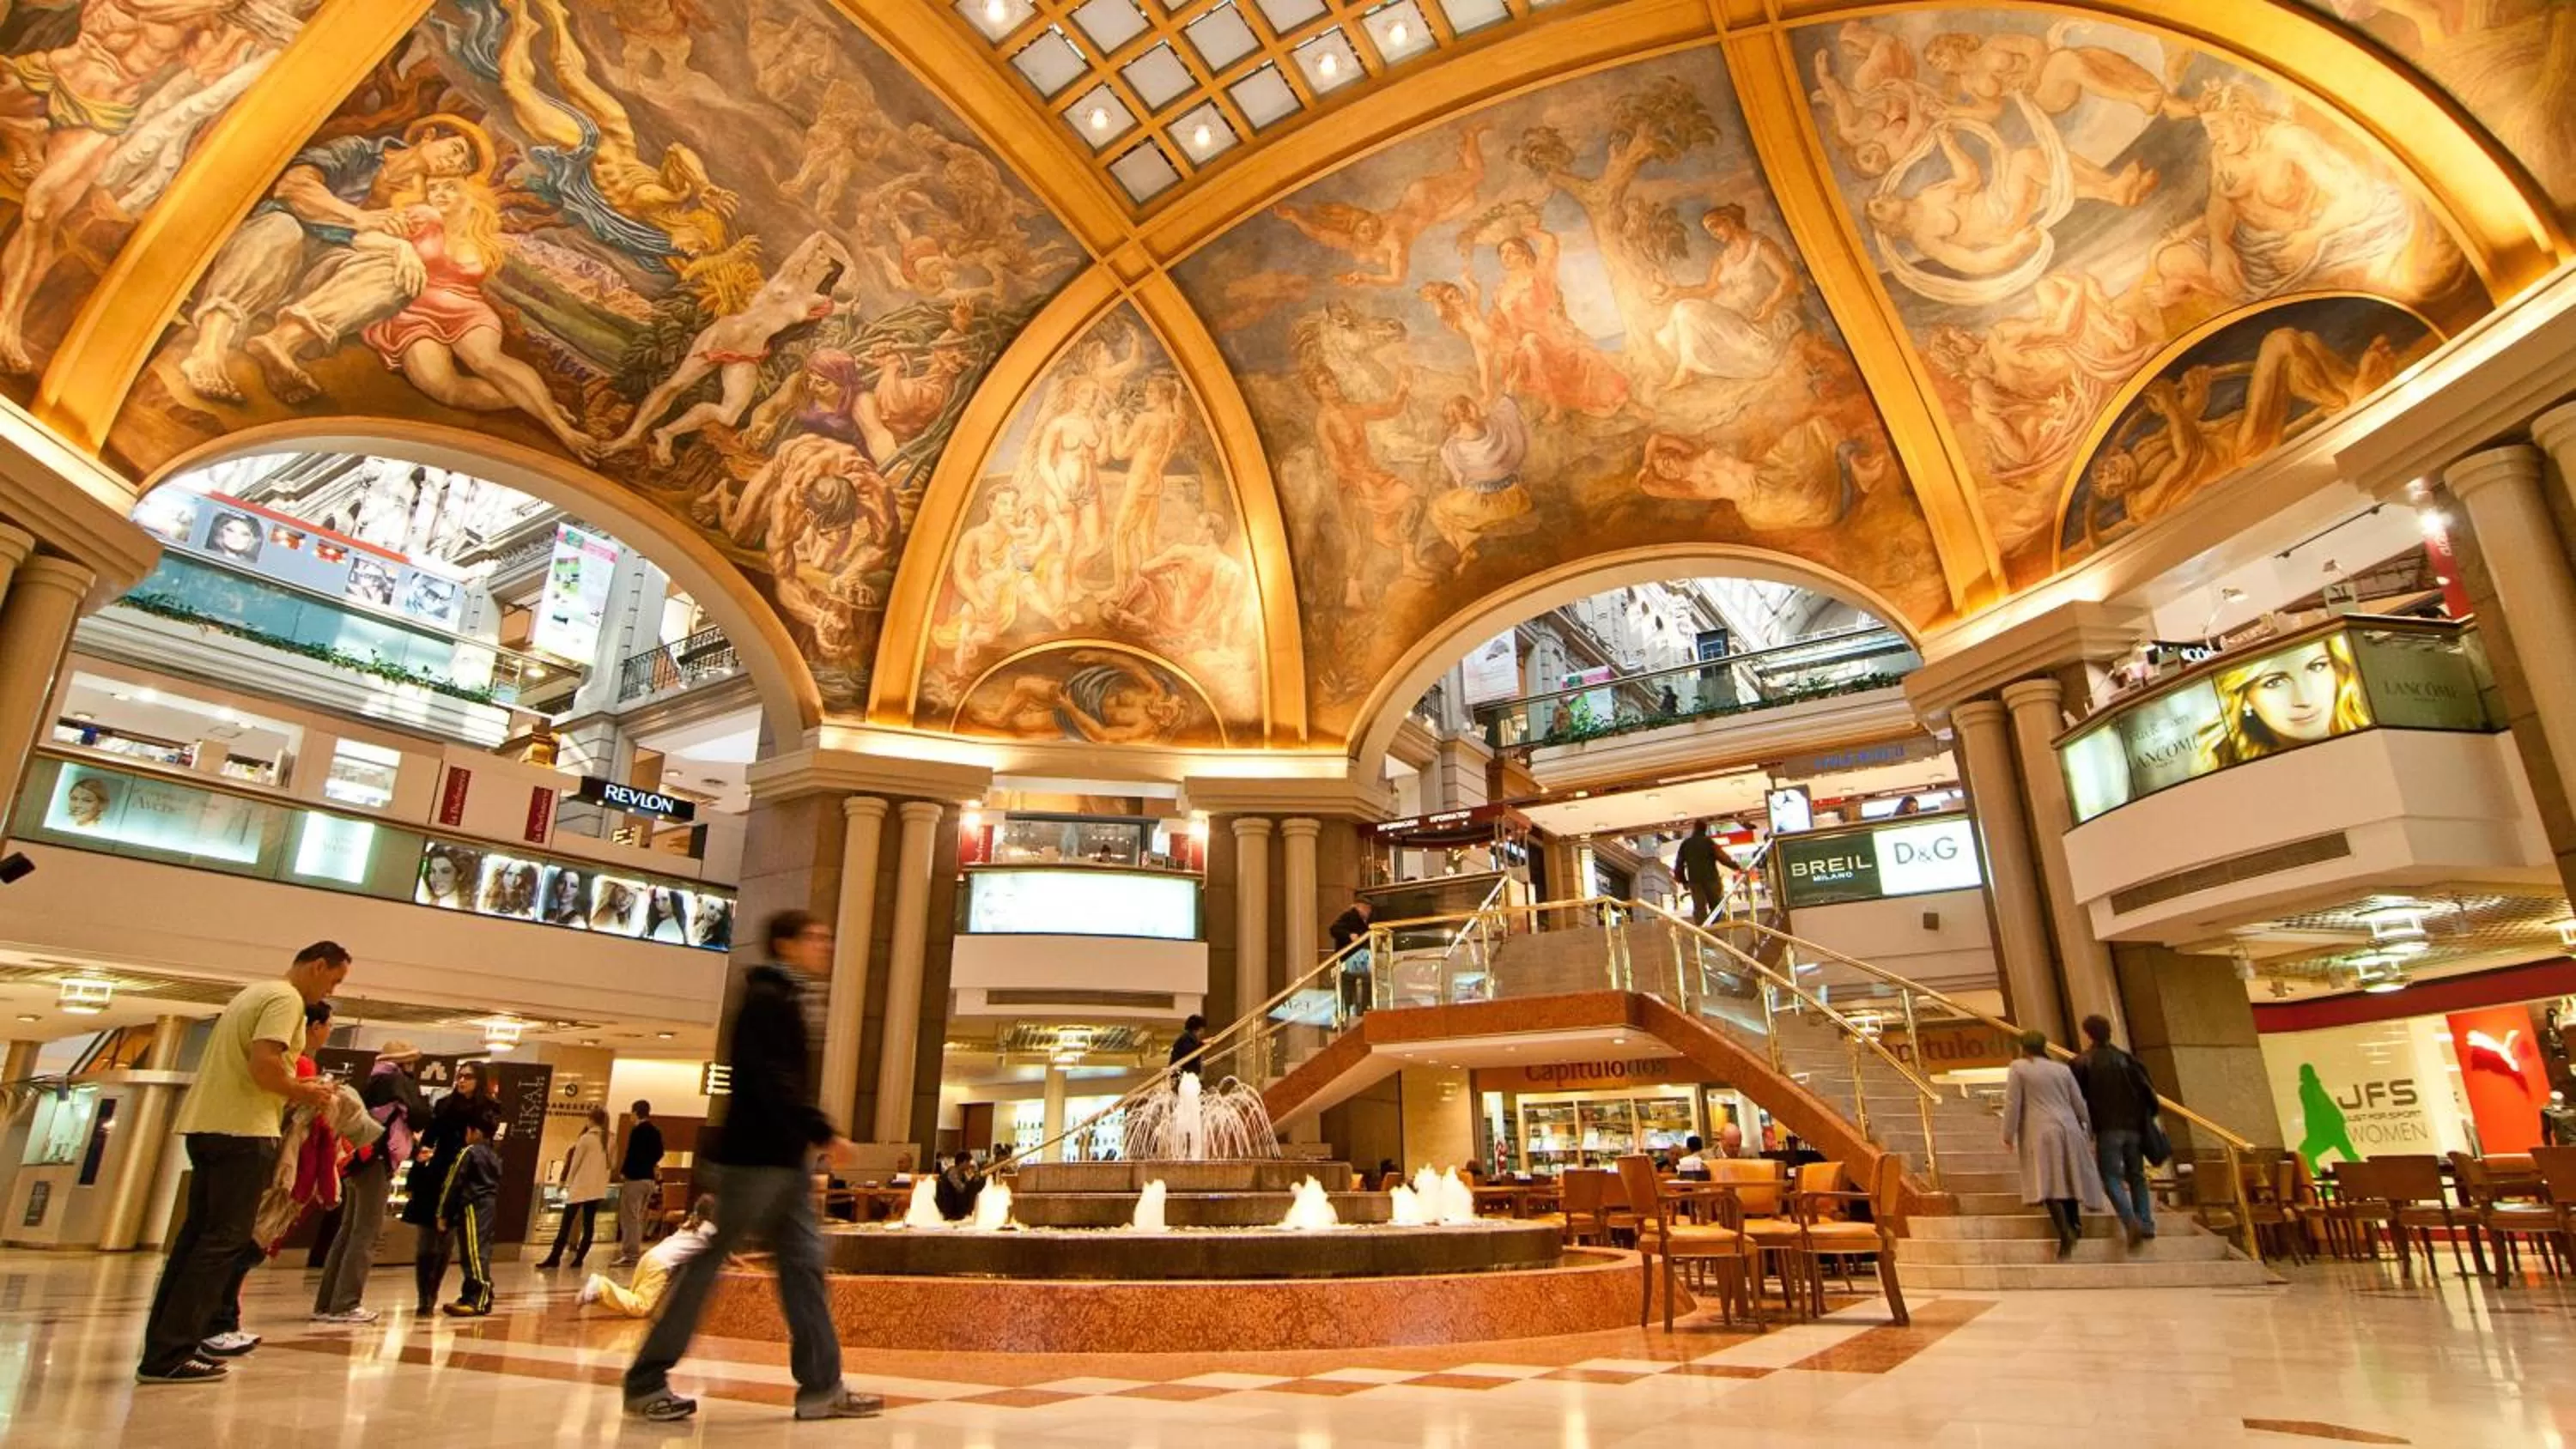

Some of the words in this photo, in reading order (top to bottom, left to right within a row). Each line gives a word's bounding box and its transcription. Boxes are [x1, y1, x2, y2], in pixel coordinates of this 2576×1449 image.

[605, 784, 674, 813] REVLON
[1893, 836, 1959, 865] D&G
[1790, 855, 1873, 877] BREIL
[1813, 870, 1853, 882] MILANO
[2336, 1078, 2418, 1109] JFS
[2347, 1123, 2428, 1143] WOMEN
